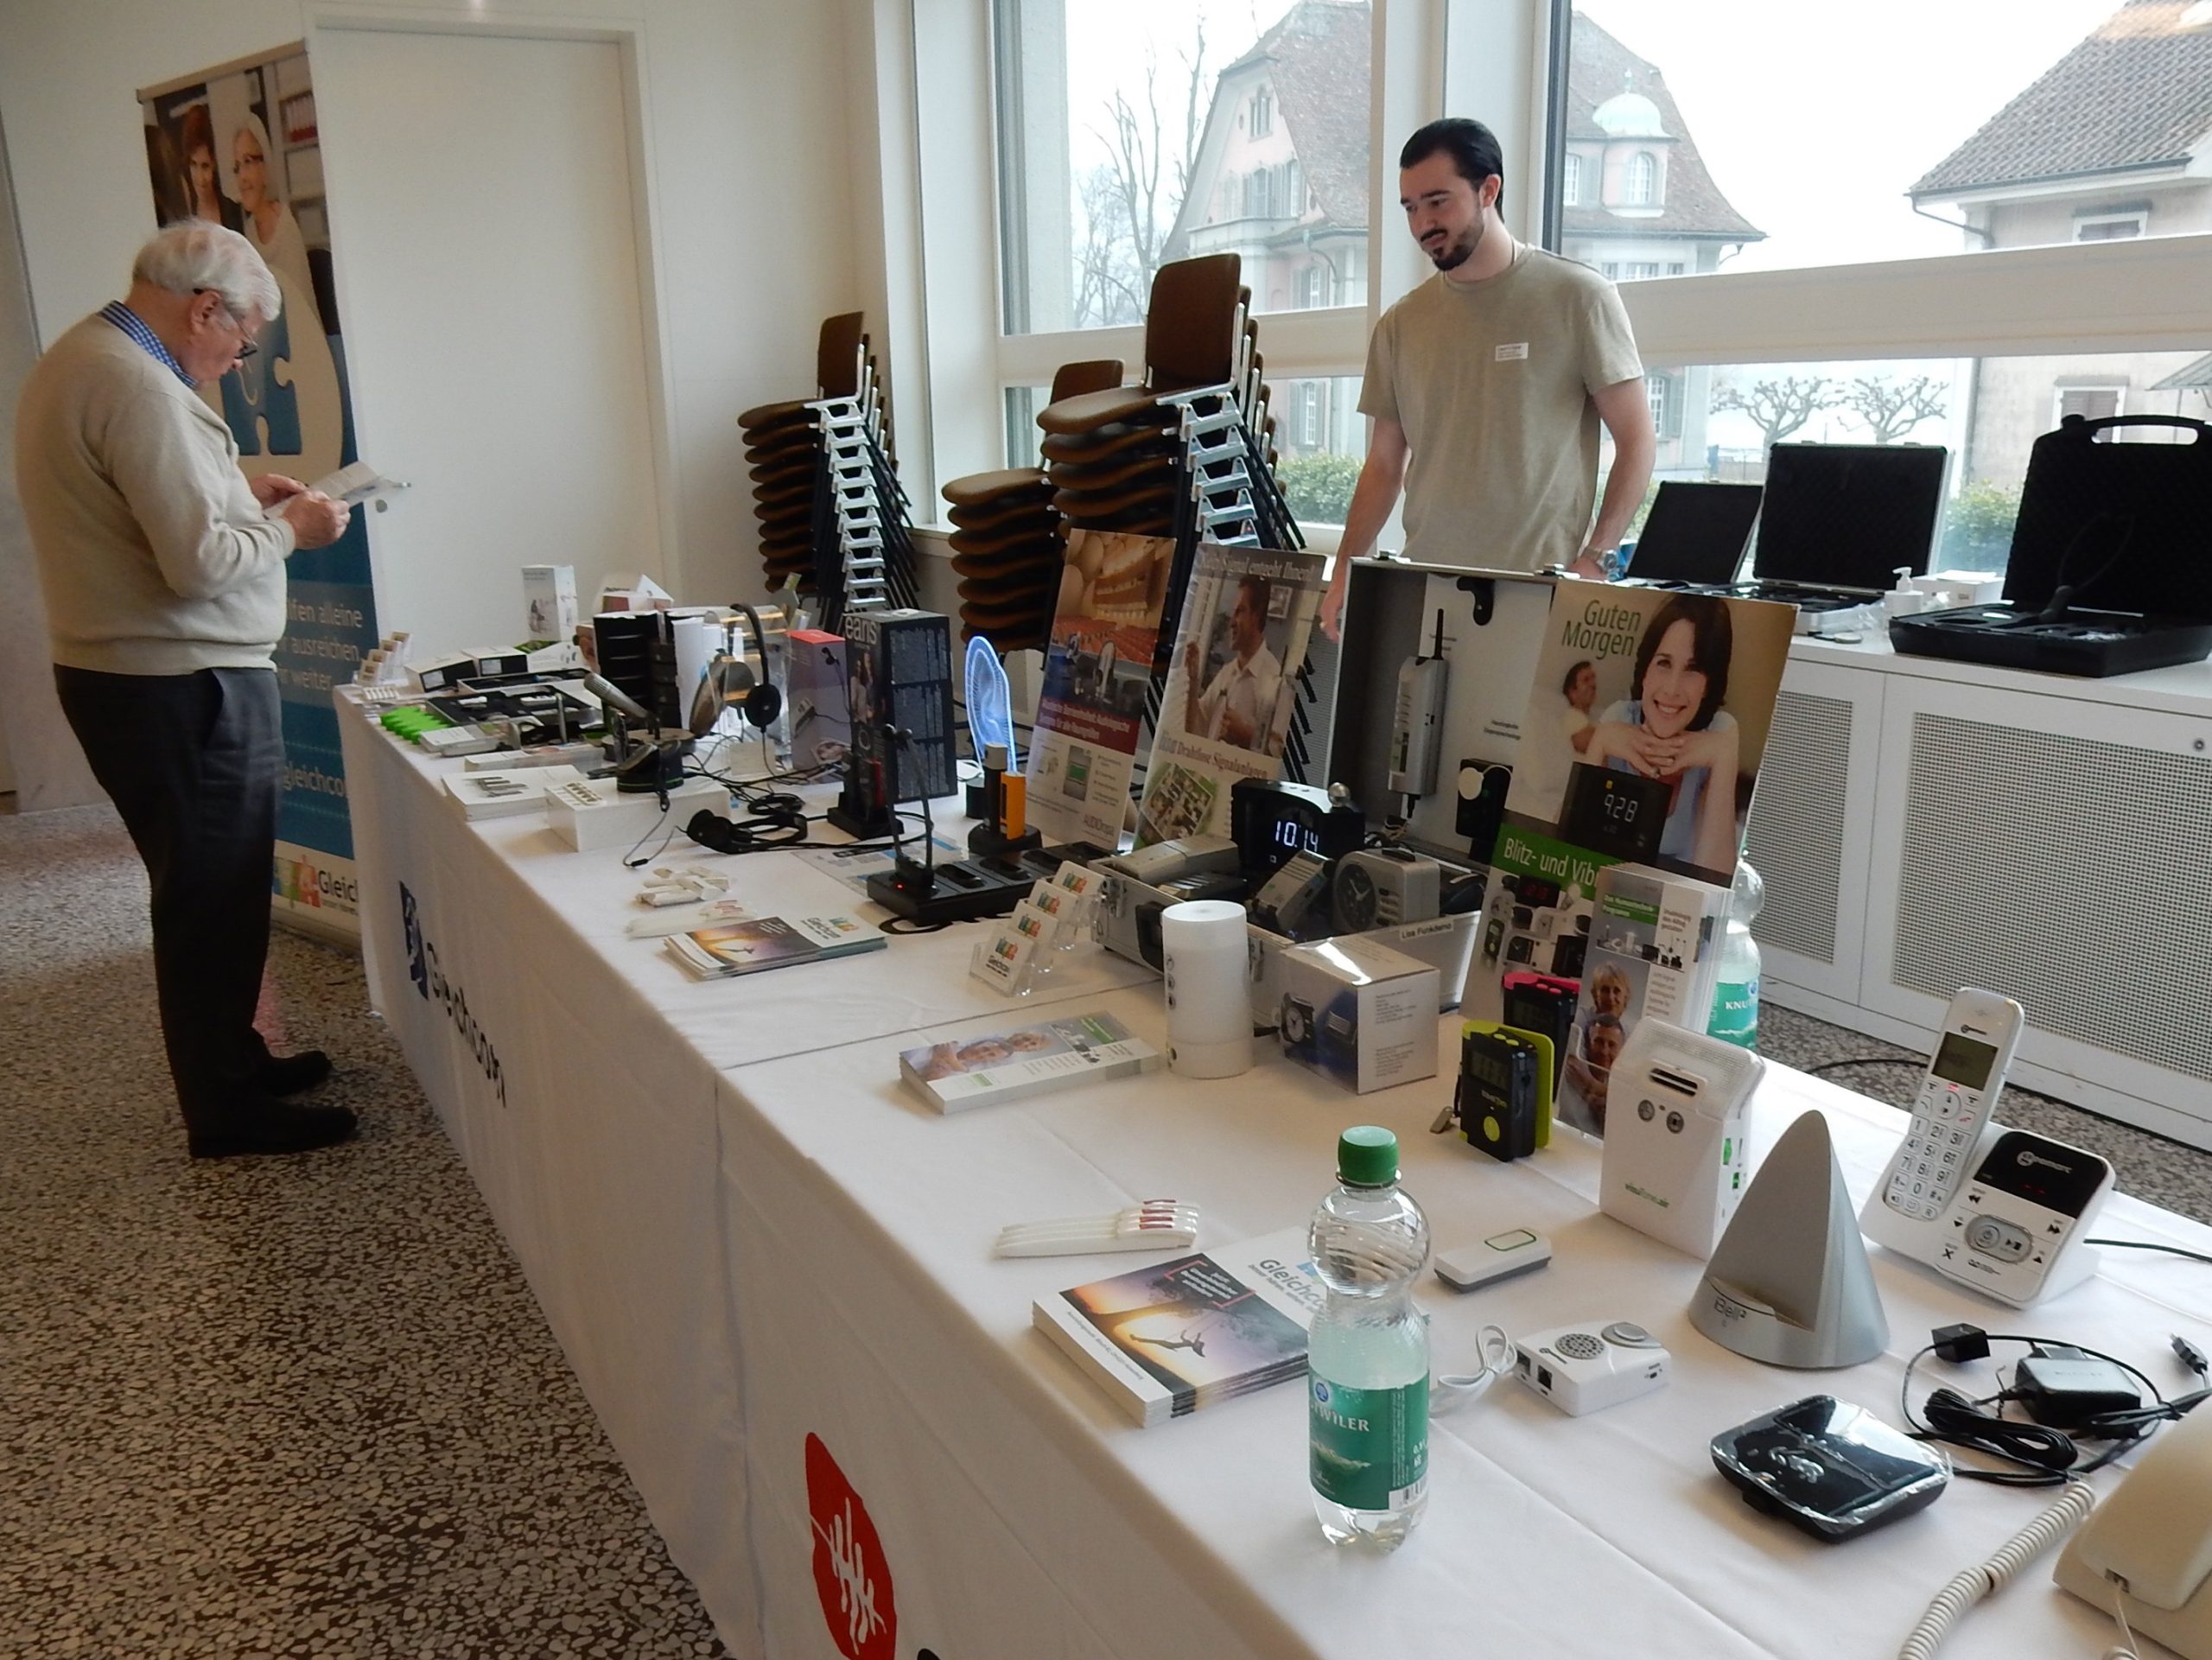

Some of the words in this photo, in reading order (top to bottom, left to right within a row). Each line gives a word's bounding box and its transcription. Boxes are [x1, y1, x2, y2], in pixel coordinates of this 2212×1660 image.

[1584, 600, 1642, 632] Guten
[1561, 620, 1635, 661] Morgen
[1503, 836, 1537, 867] Blitz-
[1539, 854, 1570, 878] und
[1259, 1259, 1326, 1307] Gleichco
[1311, 1402, 1370, 1433] TWILER
